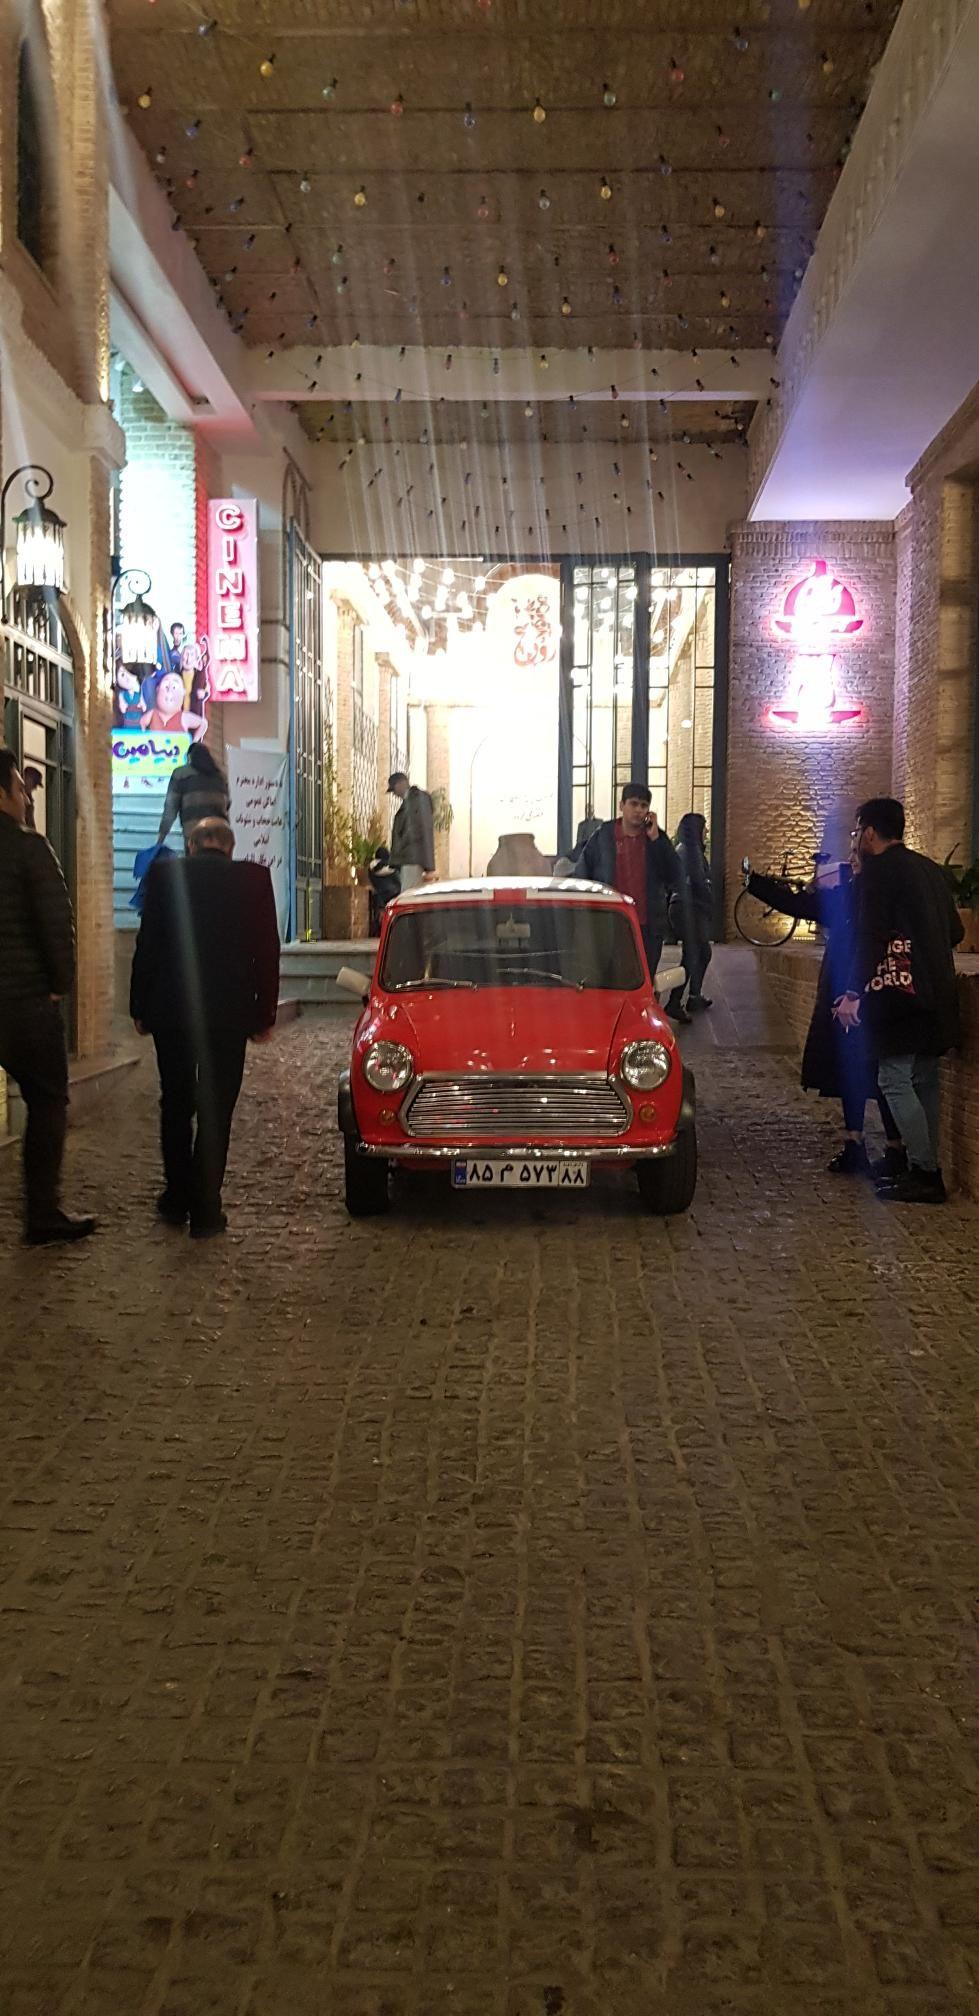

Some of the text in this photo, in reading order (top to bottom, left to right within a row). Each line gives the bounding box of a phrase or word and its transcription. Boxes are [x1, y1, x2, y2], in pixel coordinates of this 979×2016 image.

[215, 503, 247, 692] CINEMA
[112, 739, 180, 764] بنیامین
[469, 1162, 494, 1183] ۸۵
[500, 1163, 514, 1183] م
[519, 1163, 557, 1184] ۵۷۳
[561, 1167, 584, 1184] ۸۸
